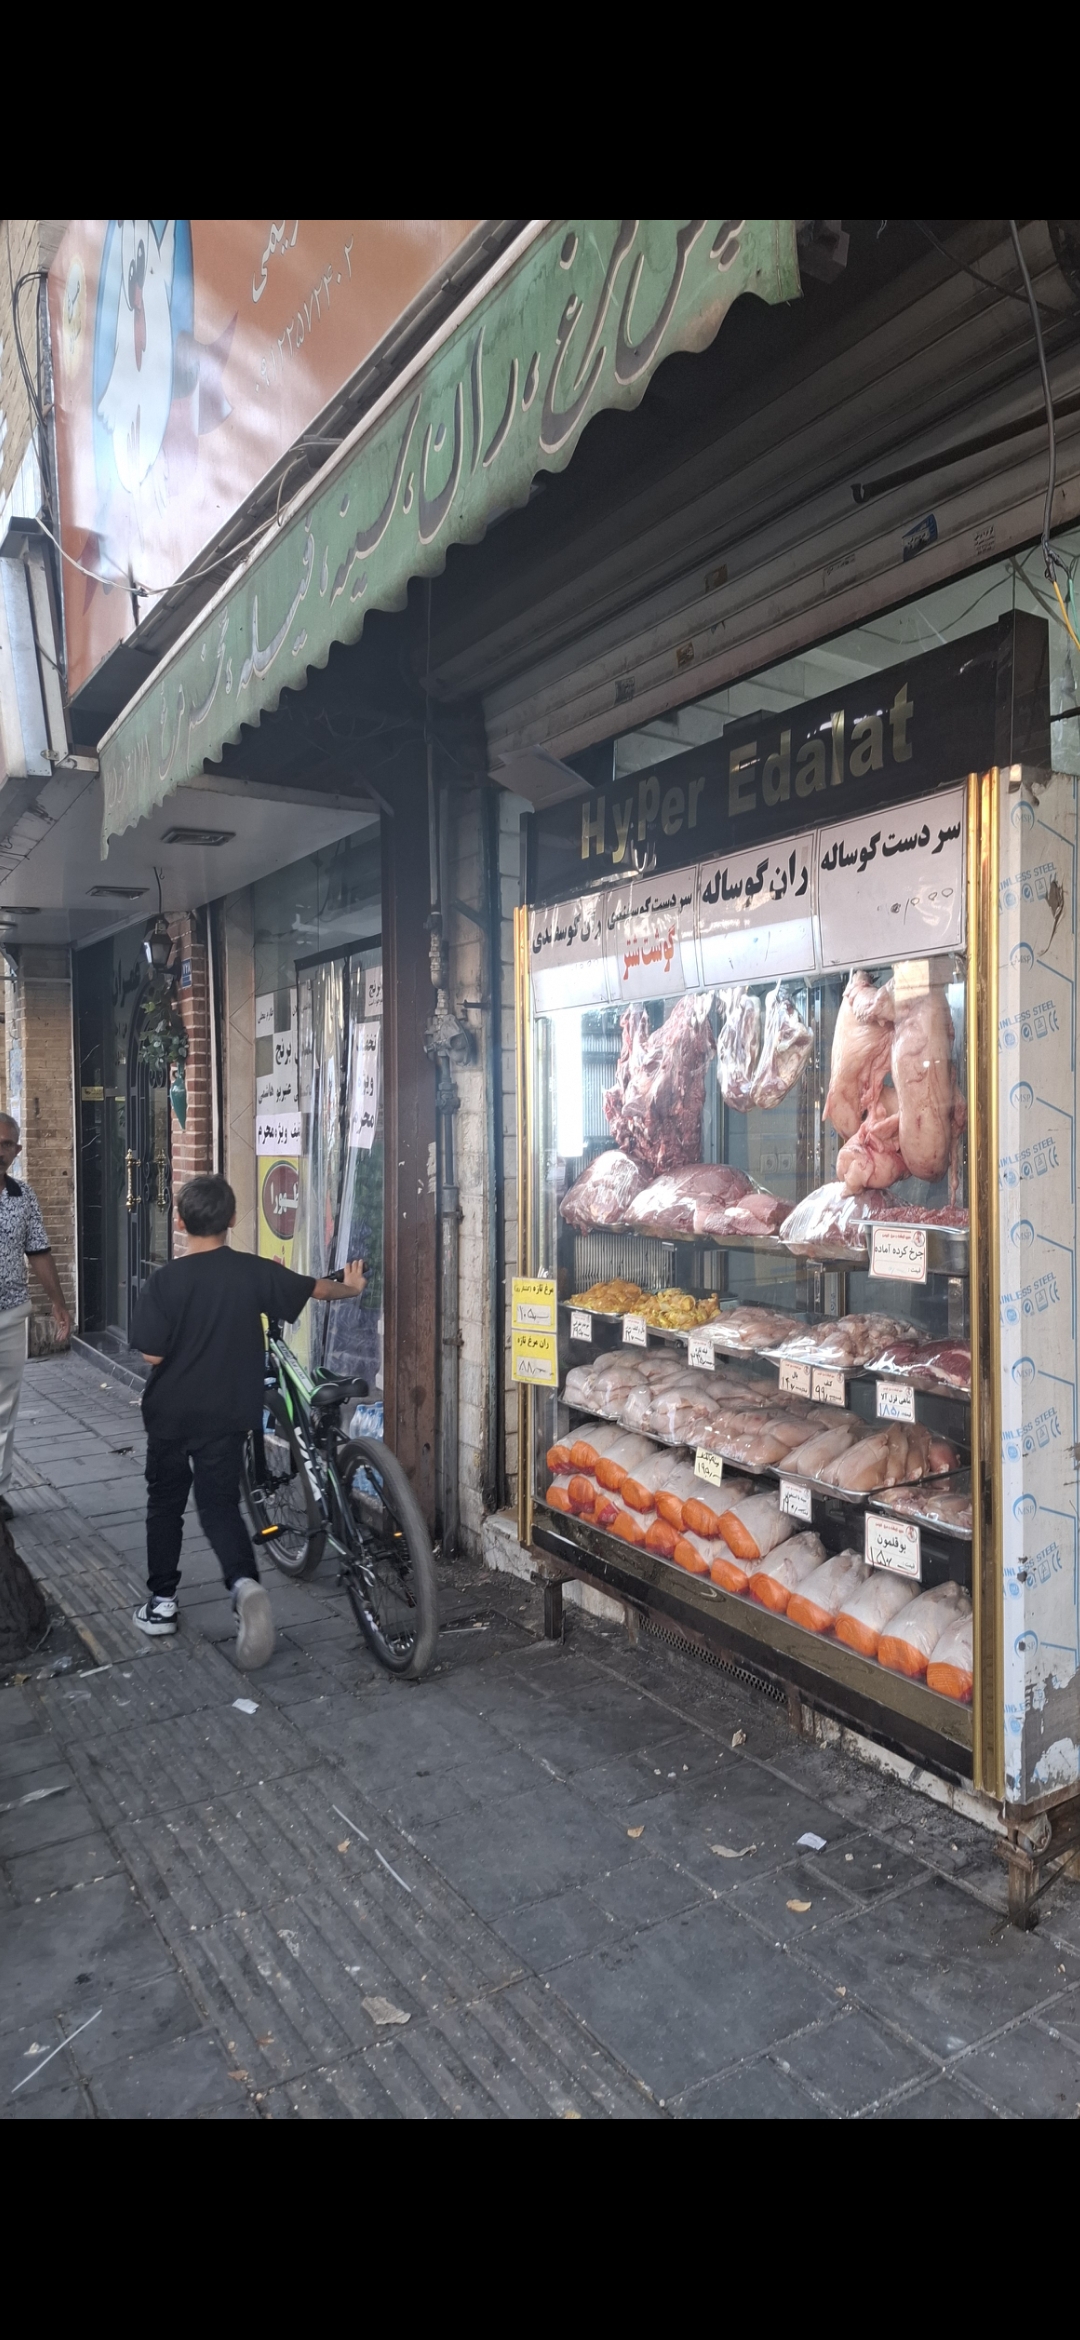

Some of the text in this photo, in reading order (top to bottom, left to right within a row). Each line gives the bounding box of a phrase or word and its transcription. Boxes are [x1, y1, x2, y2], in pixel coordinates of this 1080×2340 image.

[728, 682, 914, 817] Edalat
[820, 821, 961, 873] سر دست گوساله
[702, 848, 808, 908] ران گوساله
[1033, 861, 1057, 878] STEEL
[580, 918, 602, 943] رن
[622, 934, 641, 981] شتر
[641, 924, 676, 973] گوشت
[1033, 1000, 1056, 1017] STEEL
[275, 1037, 292, 1066] برنج
[1033, 1136, 1056, 1154] STEEL
[875, 1243, 892, 1254] آماده
[892, 1245, 909, 1259] کرده
[532, 1283, 544, 1295] تازه
[543, 1283, 555, 1296] مرغ
[1033, 1271, 1057, 1291] STEEL
[526, 1335, 538, 1347] مرغ
[539, 1338, 550, 1349] ران
[1034, 1406, 1058, 1427] STEEL
[1017, 1505, 1035, 1516] MSP
[1035, 1541, 1060, 1563] STEEL
